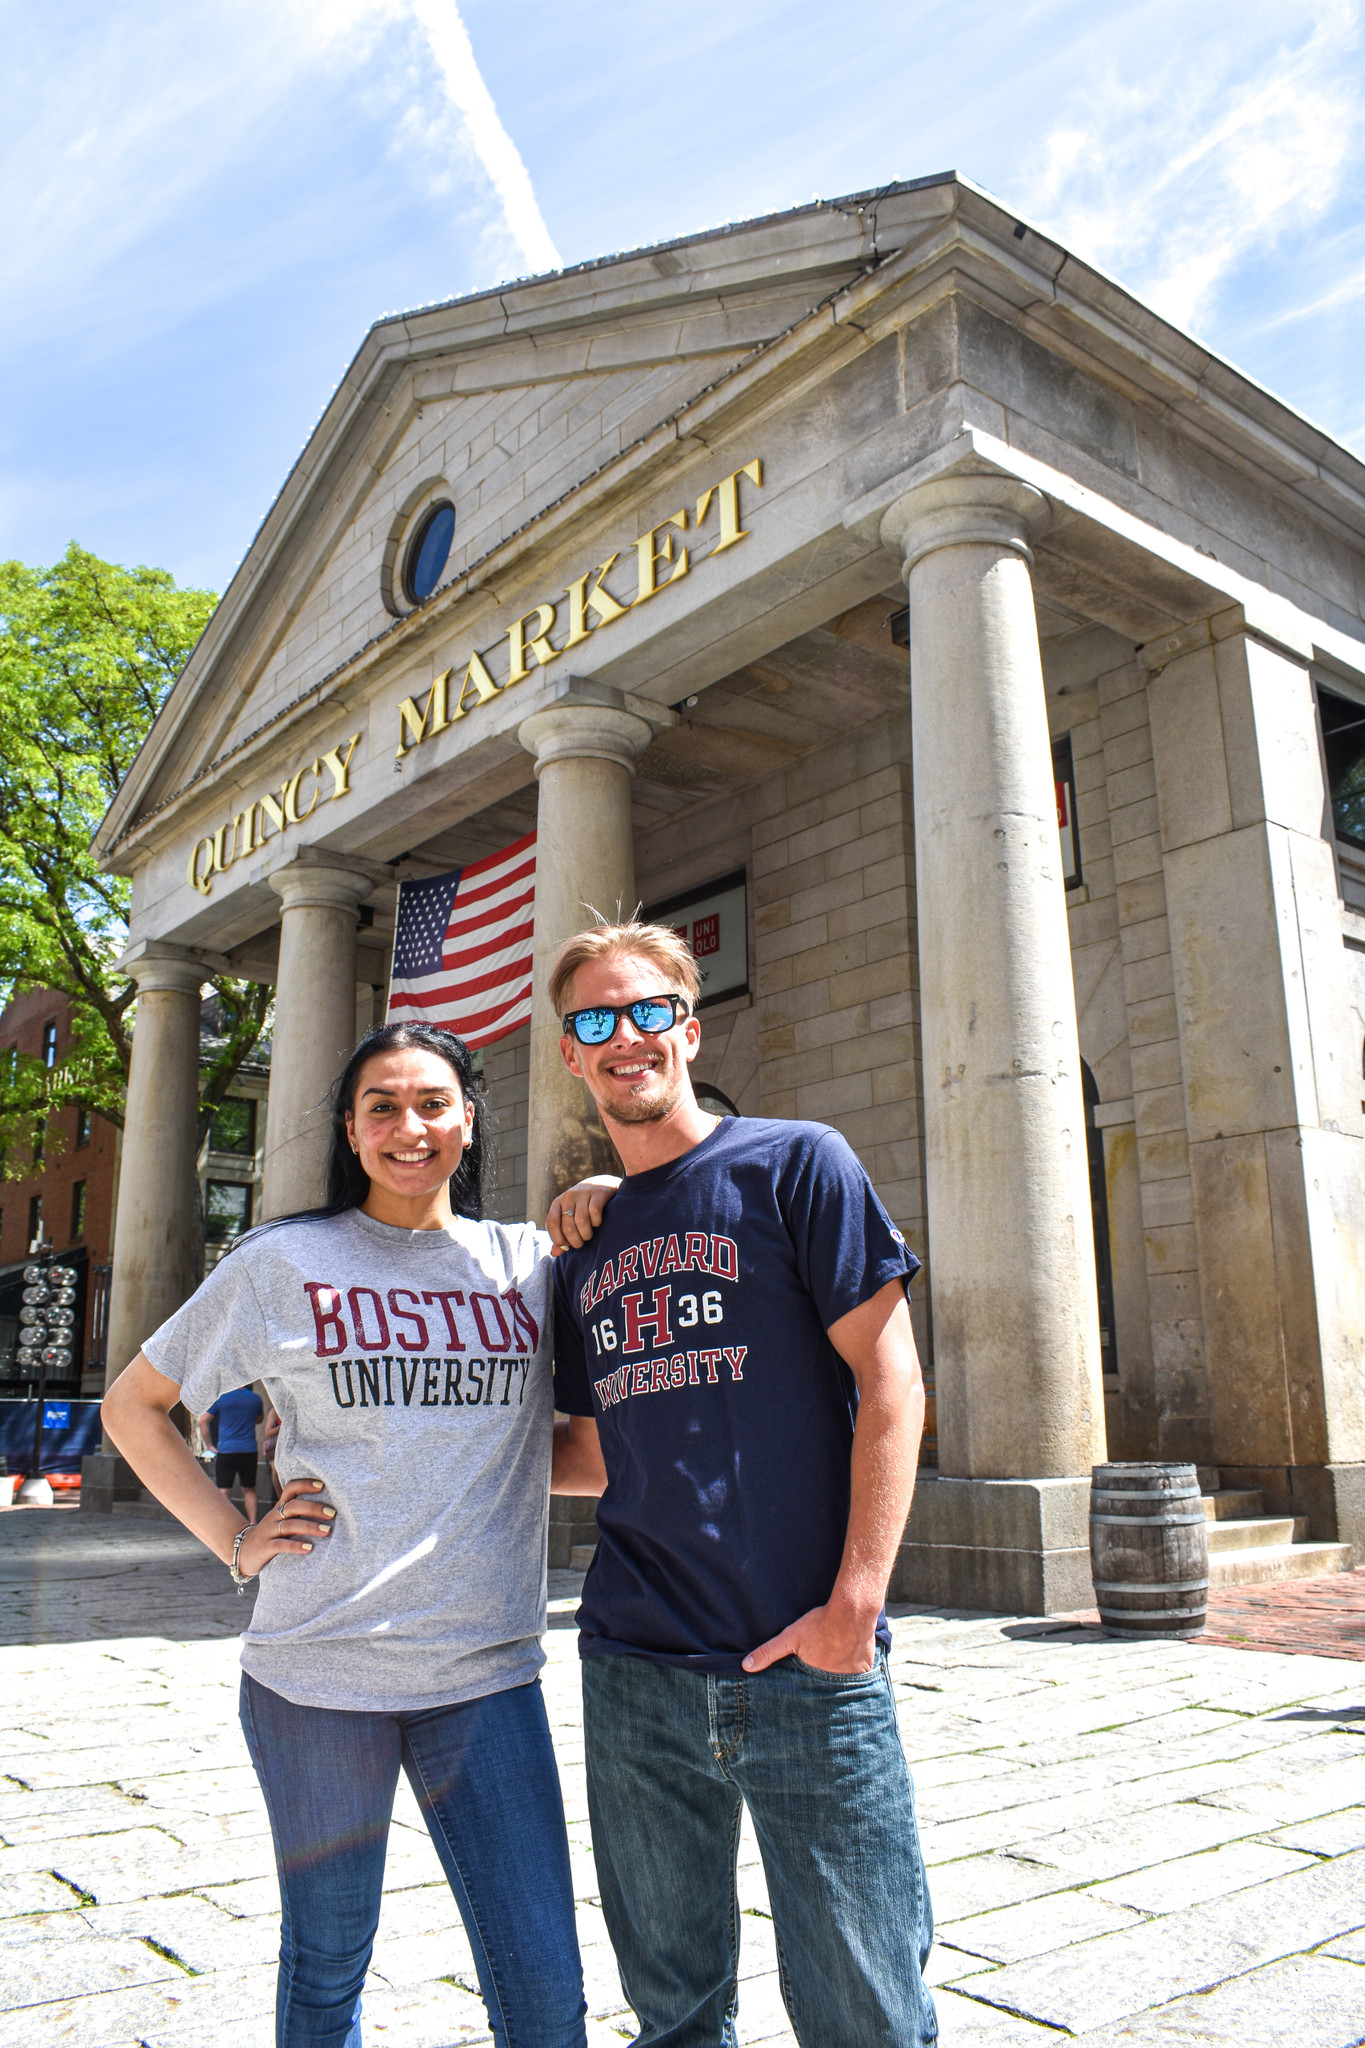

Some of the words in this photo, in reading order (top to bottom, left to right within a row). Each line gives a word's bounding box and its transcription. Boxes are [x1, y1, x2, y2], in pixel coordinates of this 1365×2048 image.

[186, 732, 362, 895] QUINCY
[395, 458, 763, 760] MARKET
[696, 920, 714, 937] UNI
[696, 936, 716, 954] QLO
[580, 1231, 739, 1316] HARVARD
[304, 1281, 539, 1358] BOSTON
[592, 1318, 618, 1356] 16
[621, 1284, 674, 1354] H
[678, 1290, 724, 1328] 36
[328, 1355, 531, 1409] UNIVERSITY
